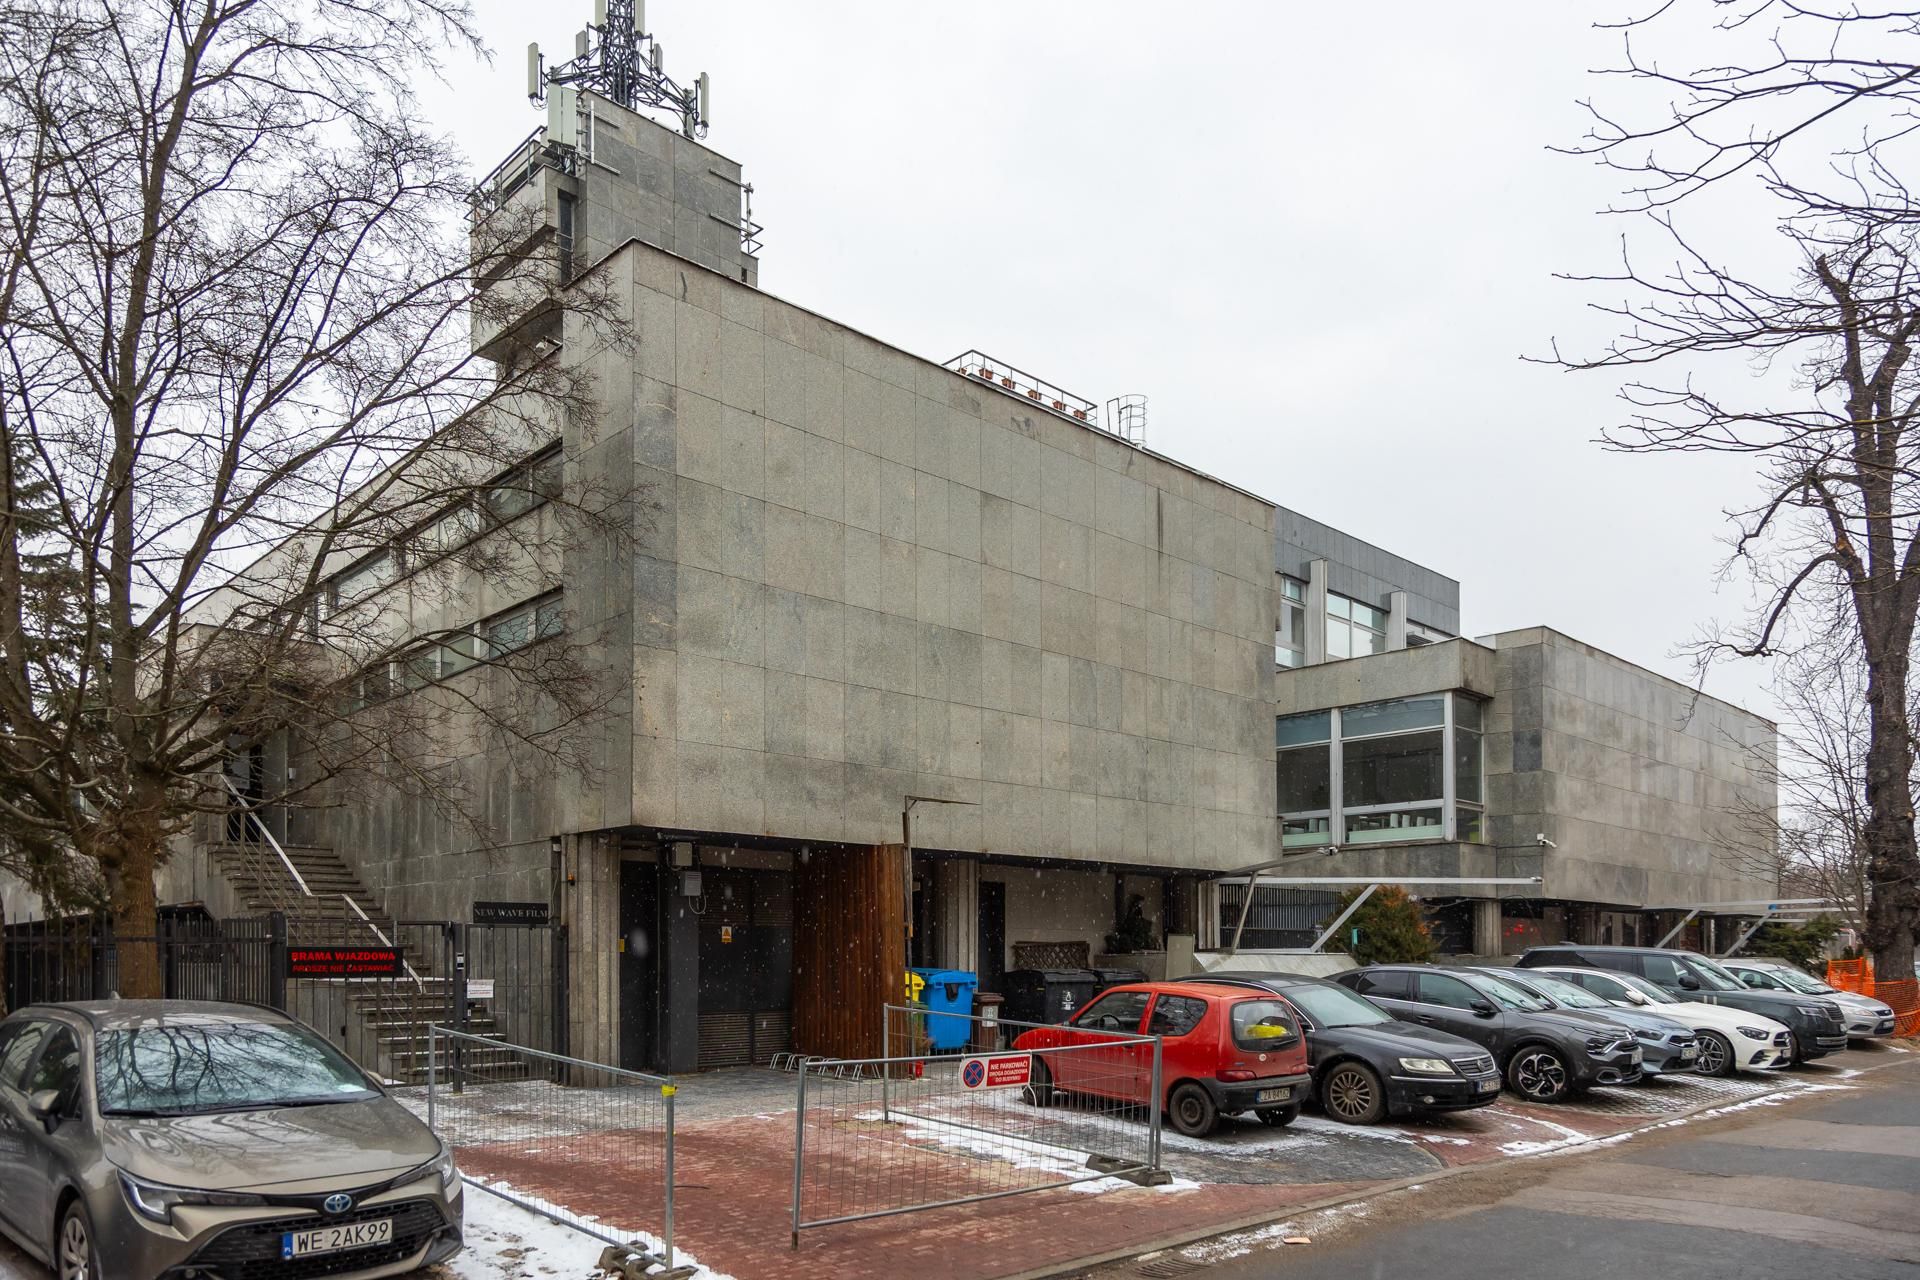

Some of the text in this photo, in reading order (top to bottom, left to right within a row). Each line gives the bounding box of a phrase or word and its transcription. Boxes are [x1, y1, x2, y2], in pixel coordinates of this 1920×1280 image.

[474, 908, 548, 918] NEW WAVE FILM
[292, 952, 395, 961] BRAMA WJAZDOWA
[330, 964, 344, 972] NIE
[298, 1232, 322, 1252] WE
[331, 1222, 389, 1247] 2AK99
